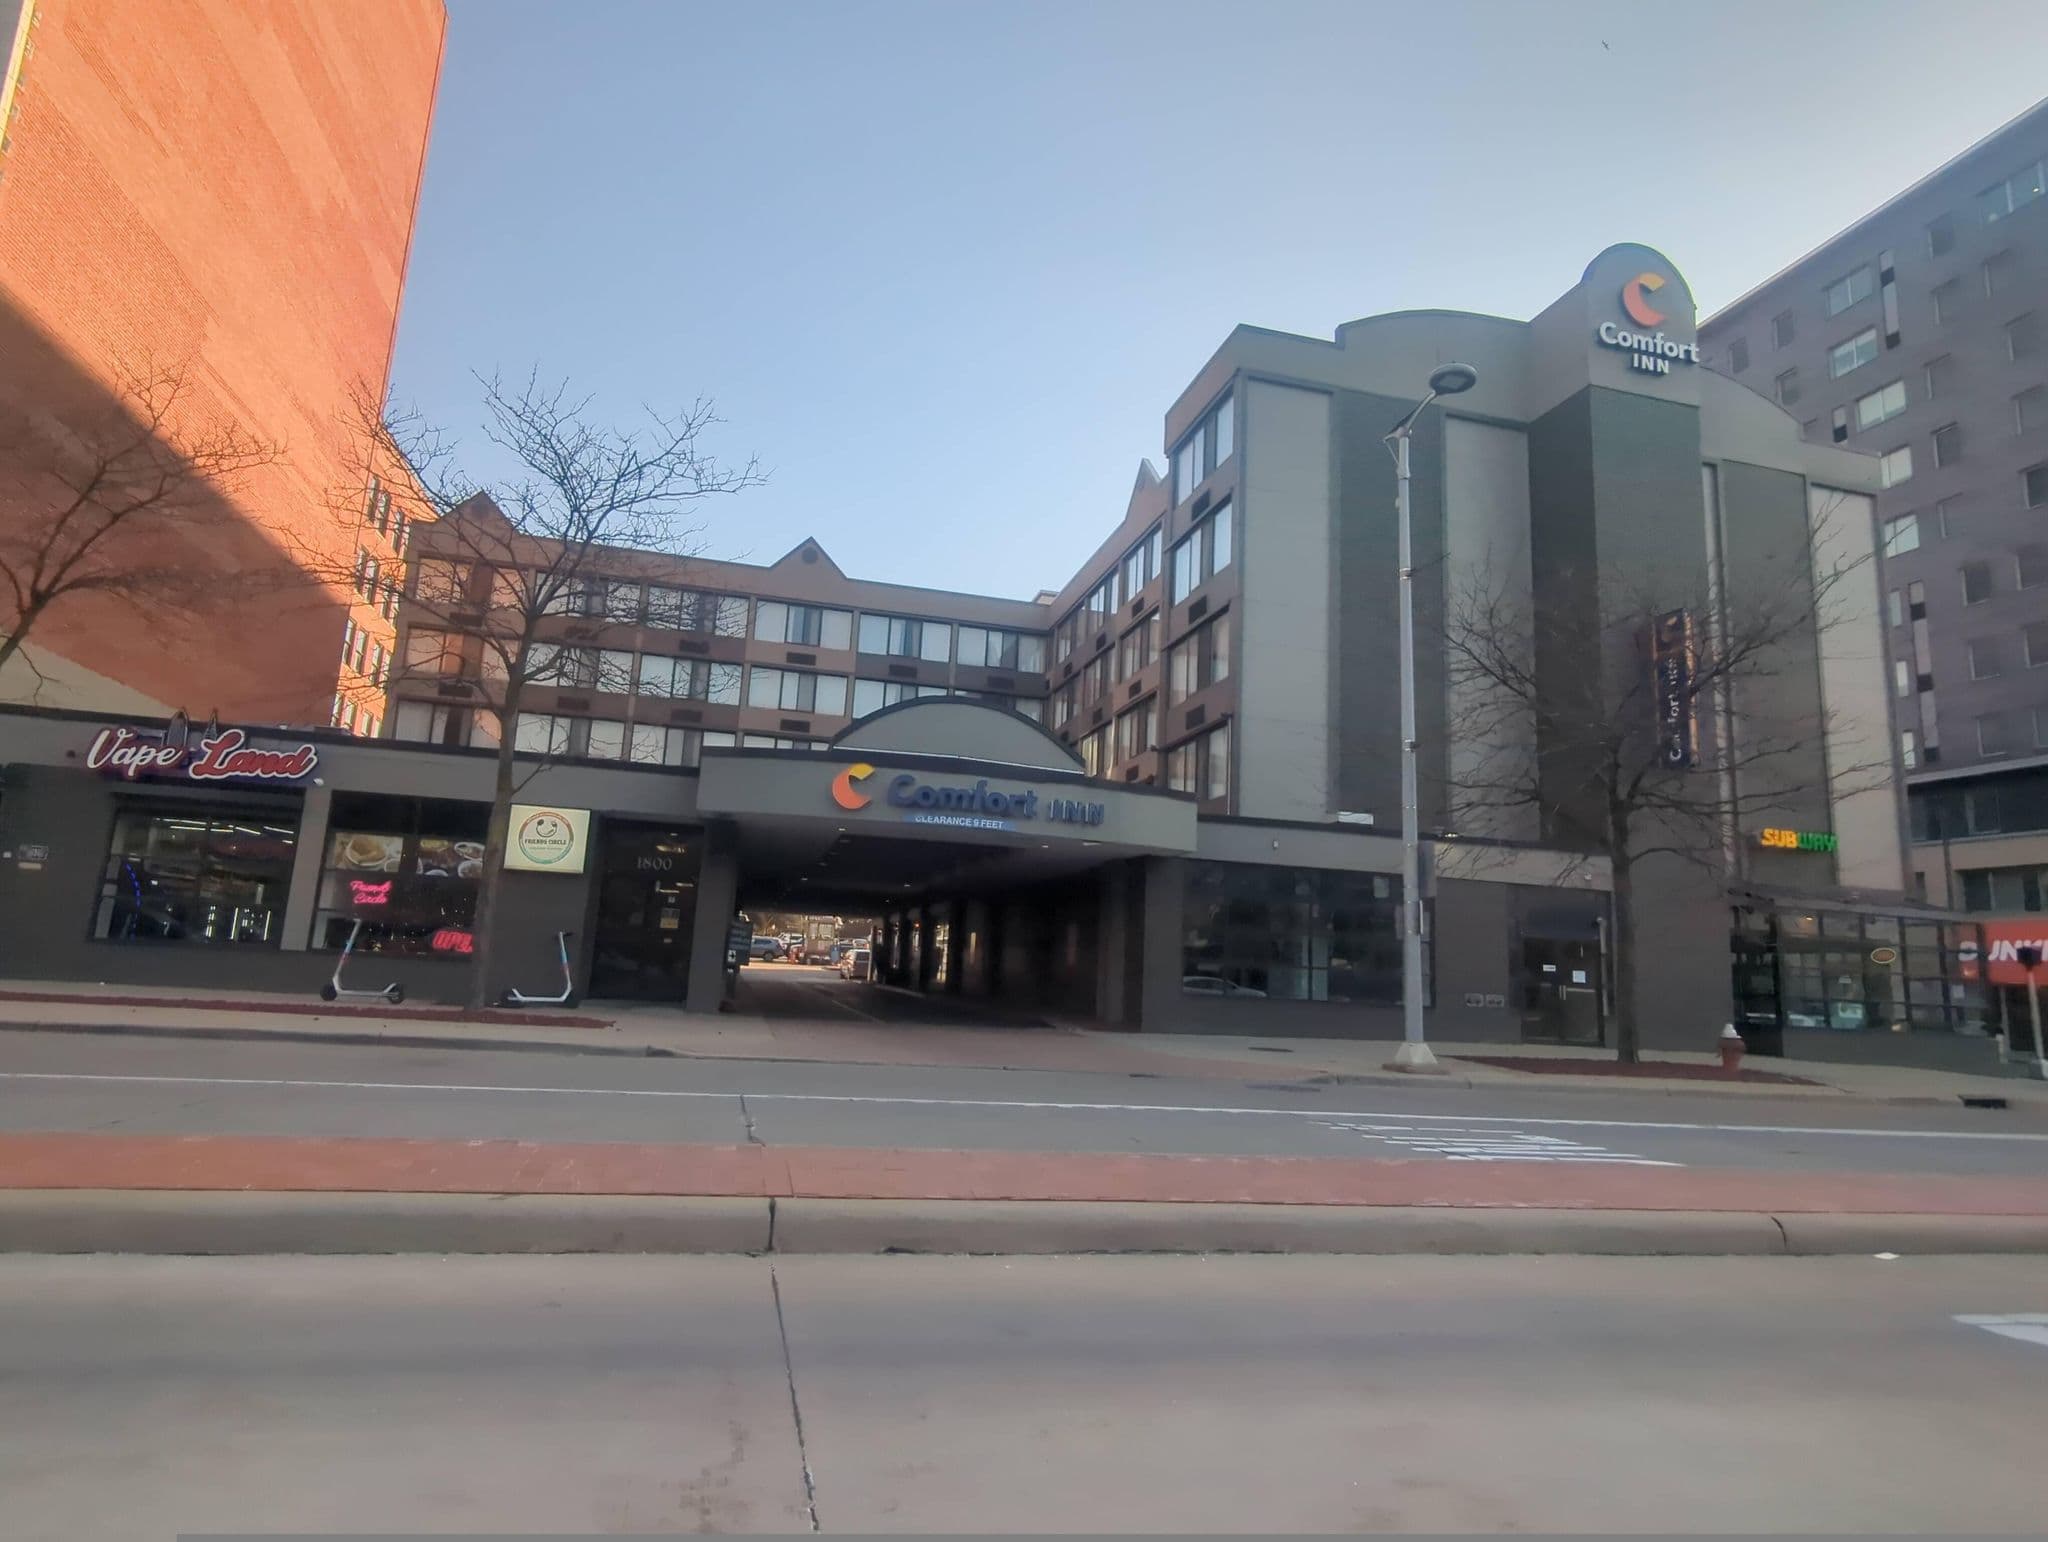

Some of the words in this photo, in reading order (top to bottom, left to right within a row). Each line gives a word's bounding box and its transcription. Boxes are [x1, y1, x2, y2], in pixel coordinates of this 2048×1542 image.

[1600, 321, 1700, 363] Comfort
[1633, 353, 1669, 374] INN
[87, 728, 183, 777] Vape
[189, 729, 318, 780] Land
[888, 774, 1038, 818] Comfort
[1048, 798, 1105, 827] INN
[914, 814, 973, 828] CLEARANCE
[973, 818, 981, 828] 9
[981, 818, 1005, 830] FEET
[1761, 828, 1837, 851] SUBWAY
[637, 855, 673, 871] 1800
